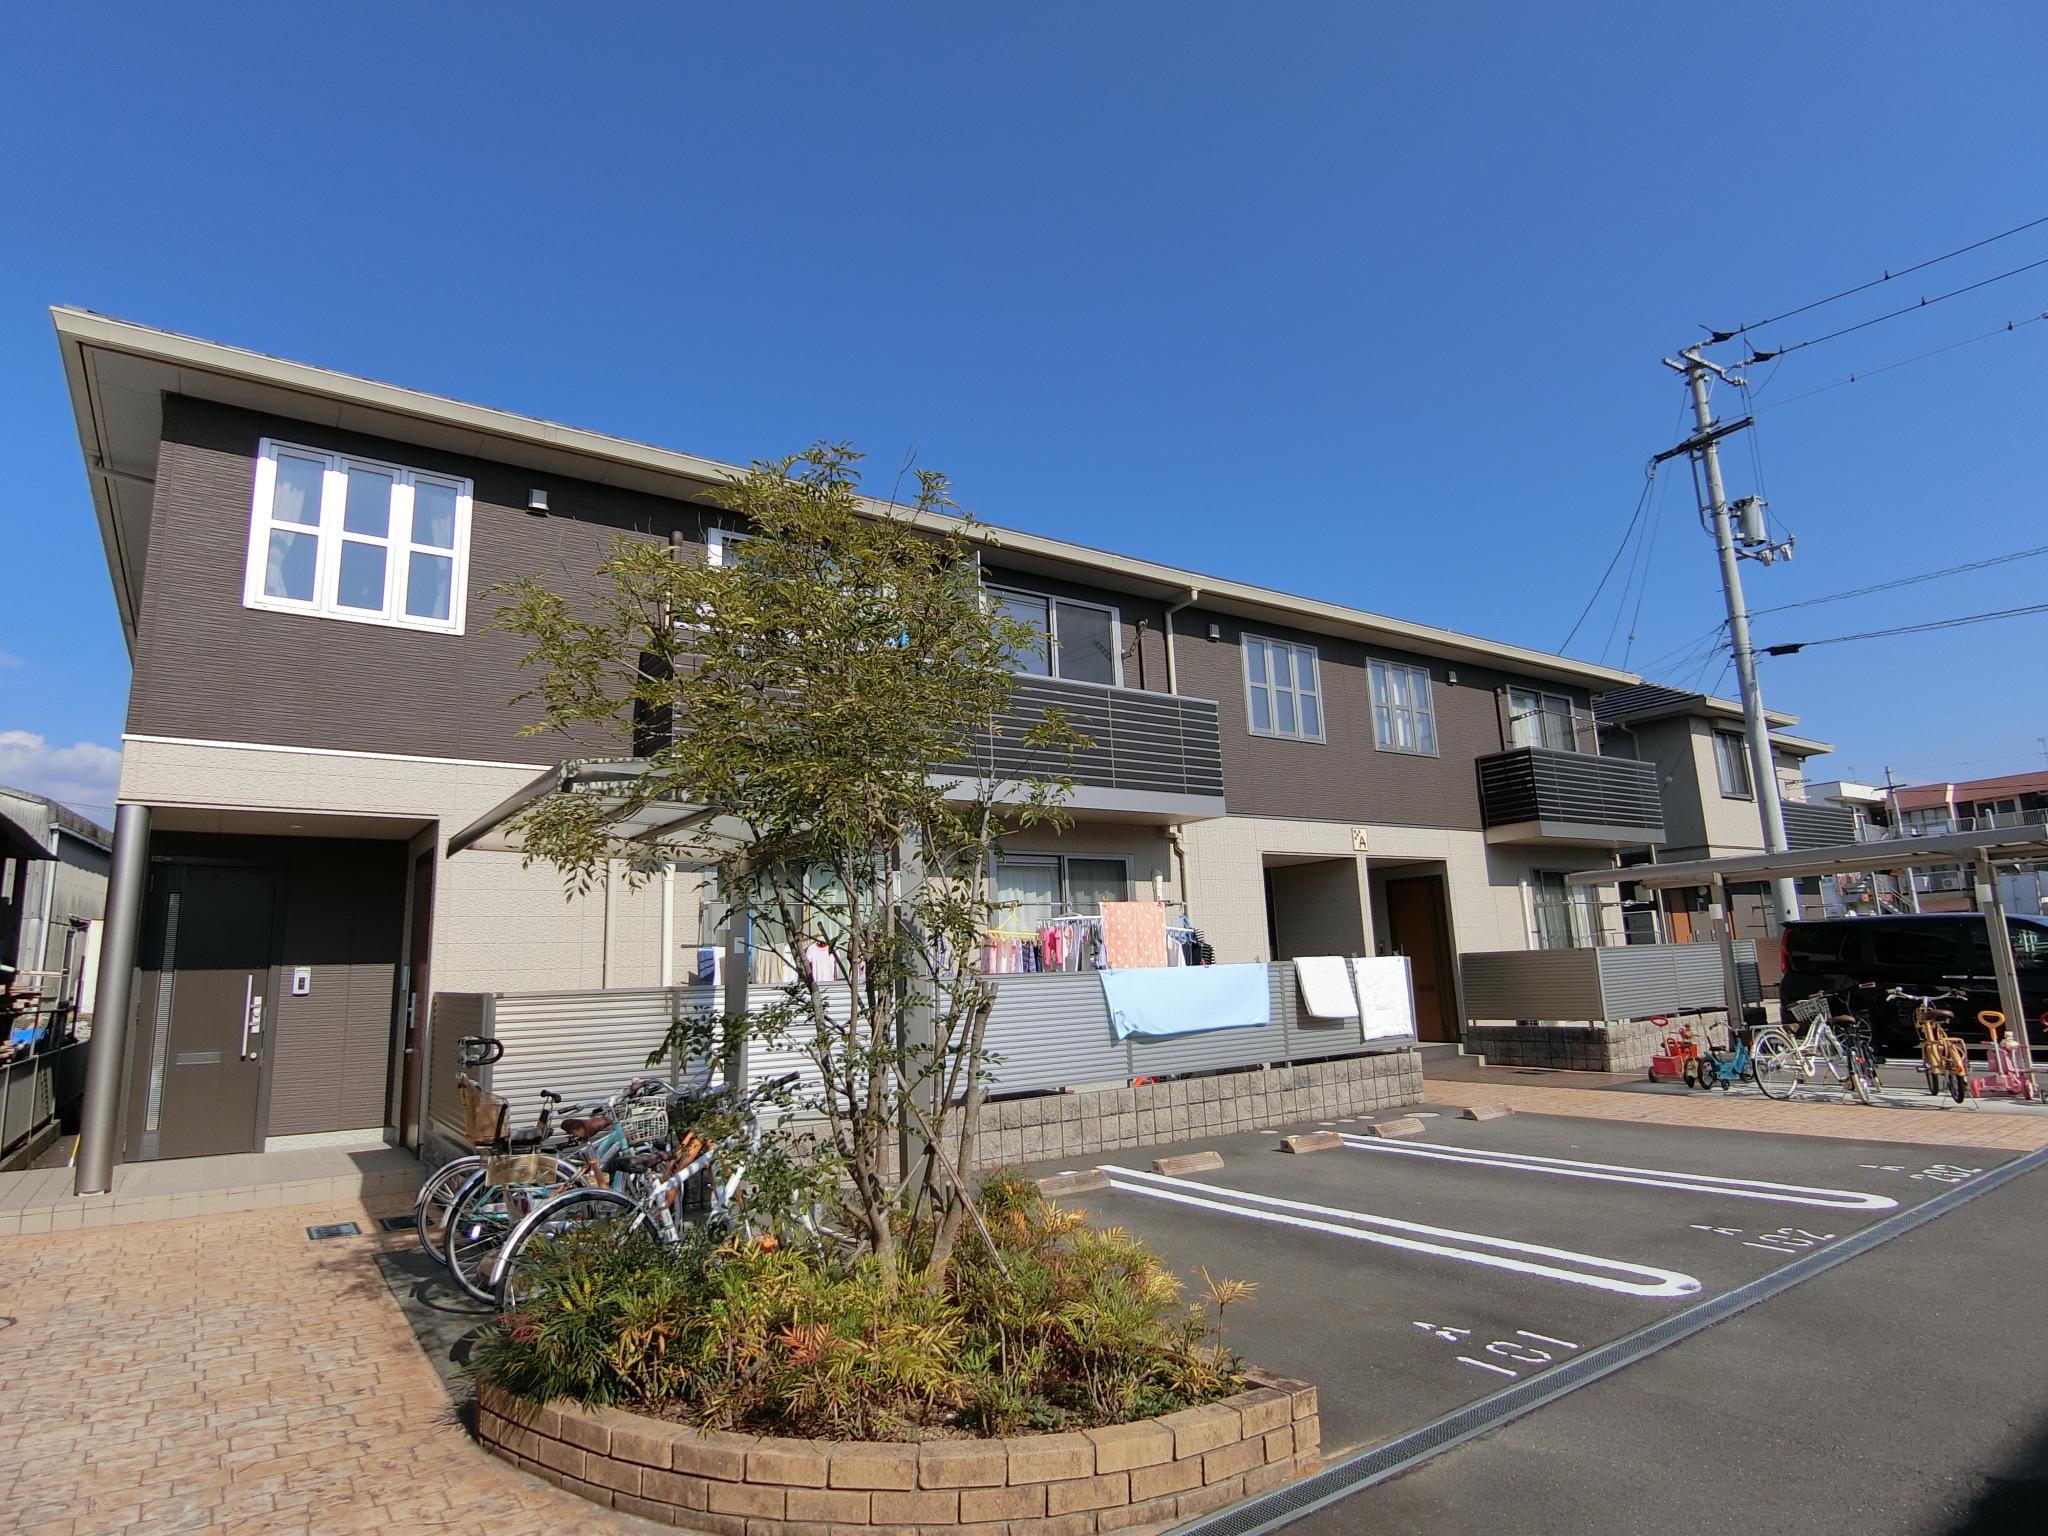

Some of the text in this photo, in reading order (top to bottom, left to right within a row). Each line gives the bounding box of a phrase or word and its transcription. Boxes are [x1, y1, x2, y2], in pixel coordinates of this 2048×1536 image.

[1359, 836, 1366, 849] A
[1908, 1164, 1983, 1183] 202
[1741, 1227, 1836, 1253] 102
[1455, 1329, 1579, 1377] 101
